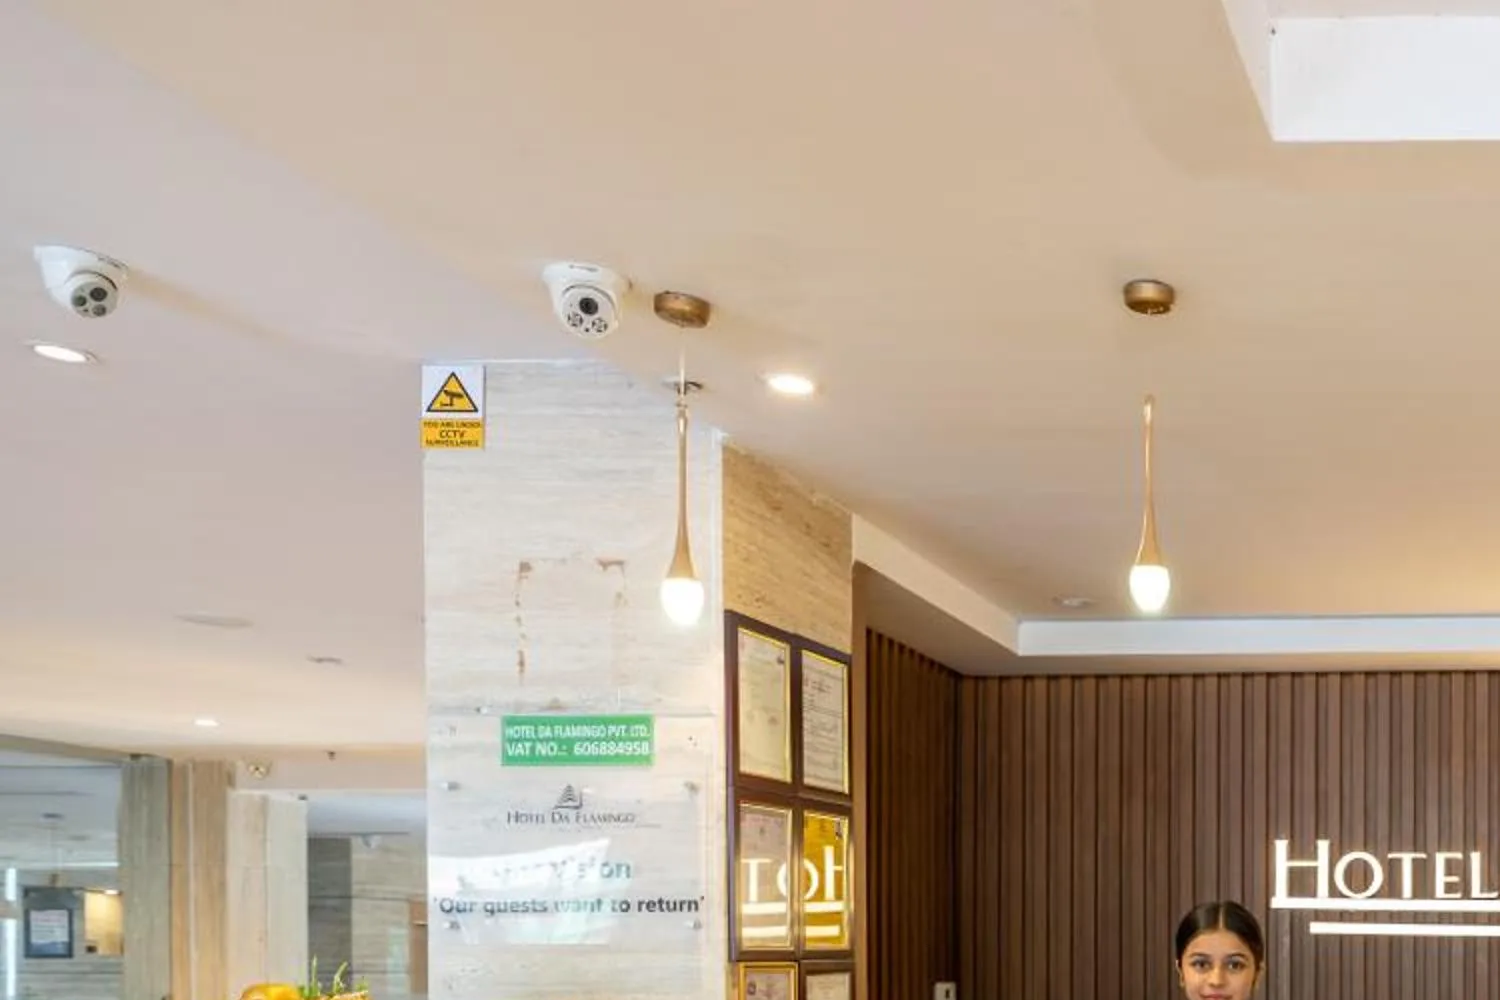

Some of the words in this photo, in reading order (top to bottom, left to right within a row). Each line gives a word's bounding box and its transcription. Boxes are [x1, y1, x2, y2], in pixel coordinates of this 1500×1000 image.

[439, 429, 466, 439] CCTV
[505, 724, 536, 738] HOTEL
[537, 725, 553, 738] DA
[554, 724, 606, 738] FLAMINGO
[505, 741, 534, 757] VAT
[1273, 838, 1500, 899] HOTEL
[482, 899, 549, 917] guests
[610, 898, 631, 914] to
